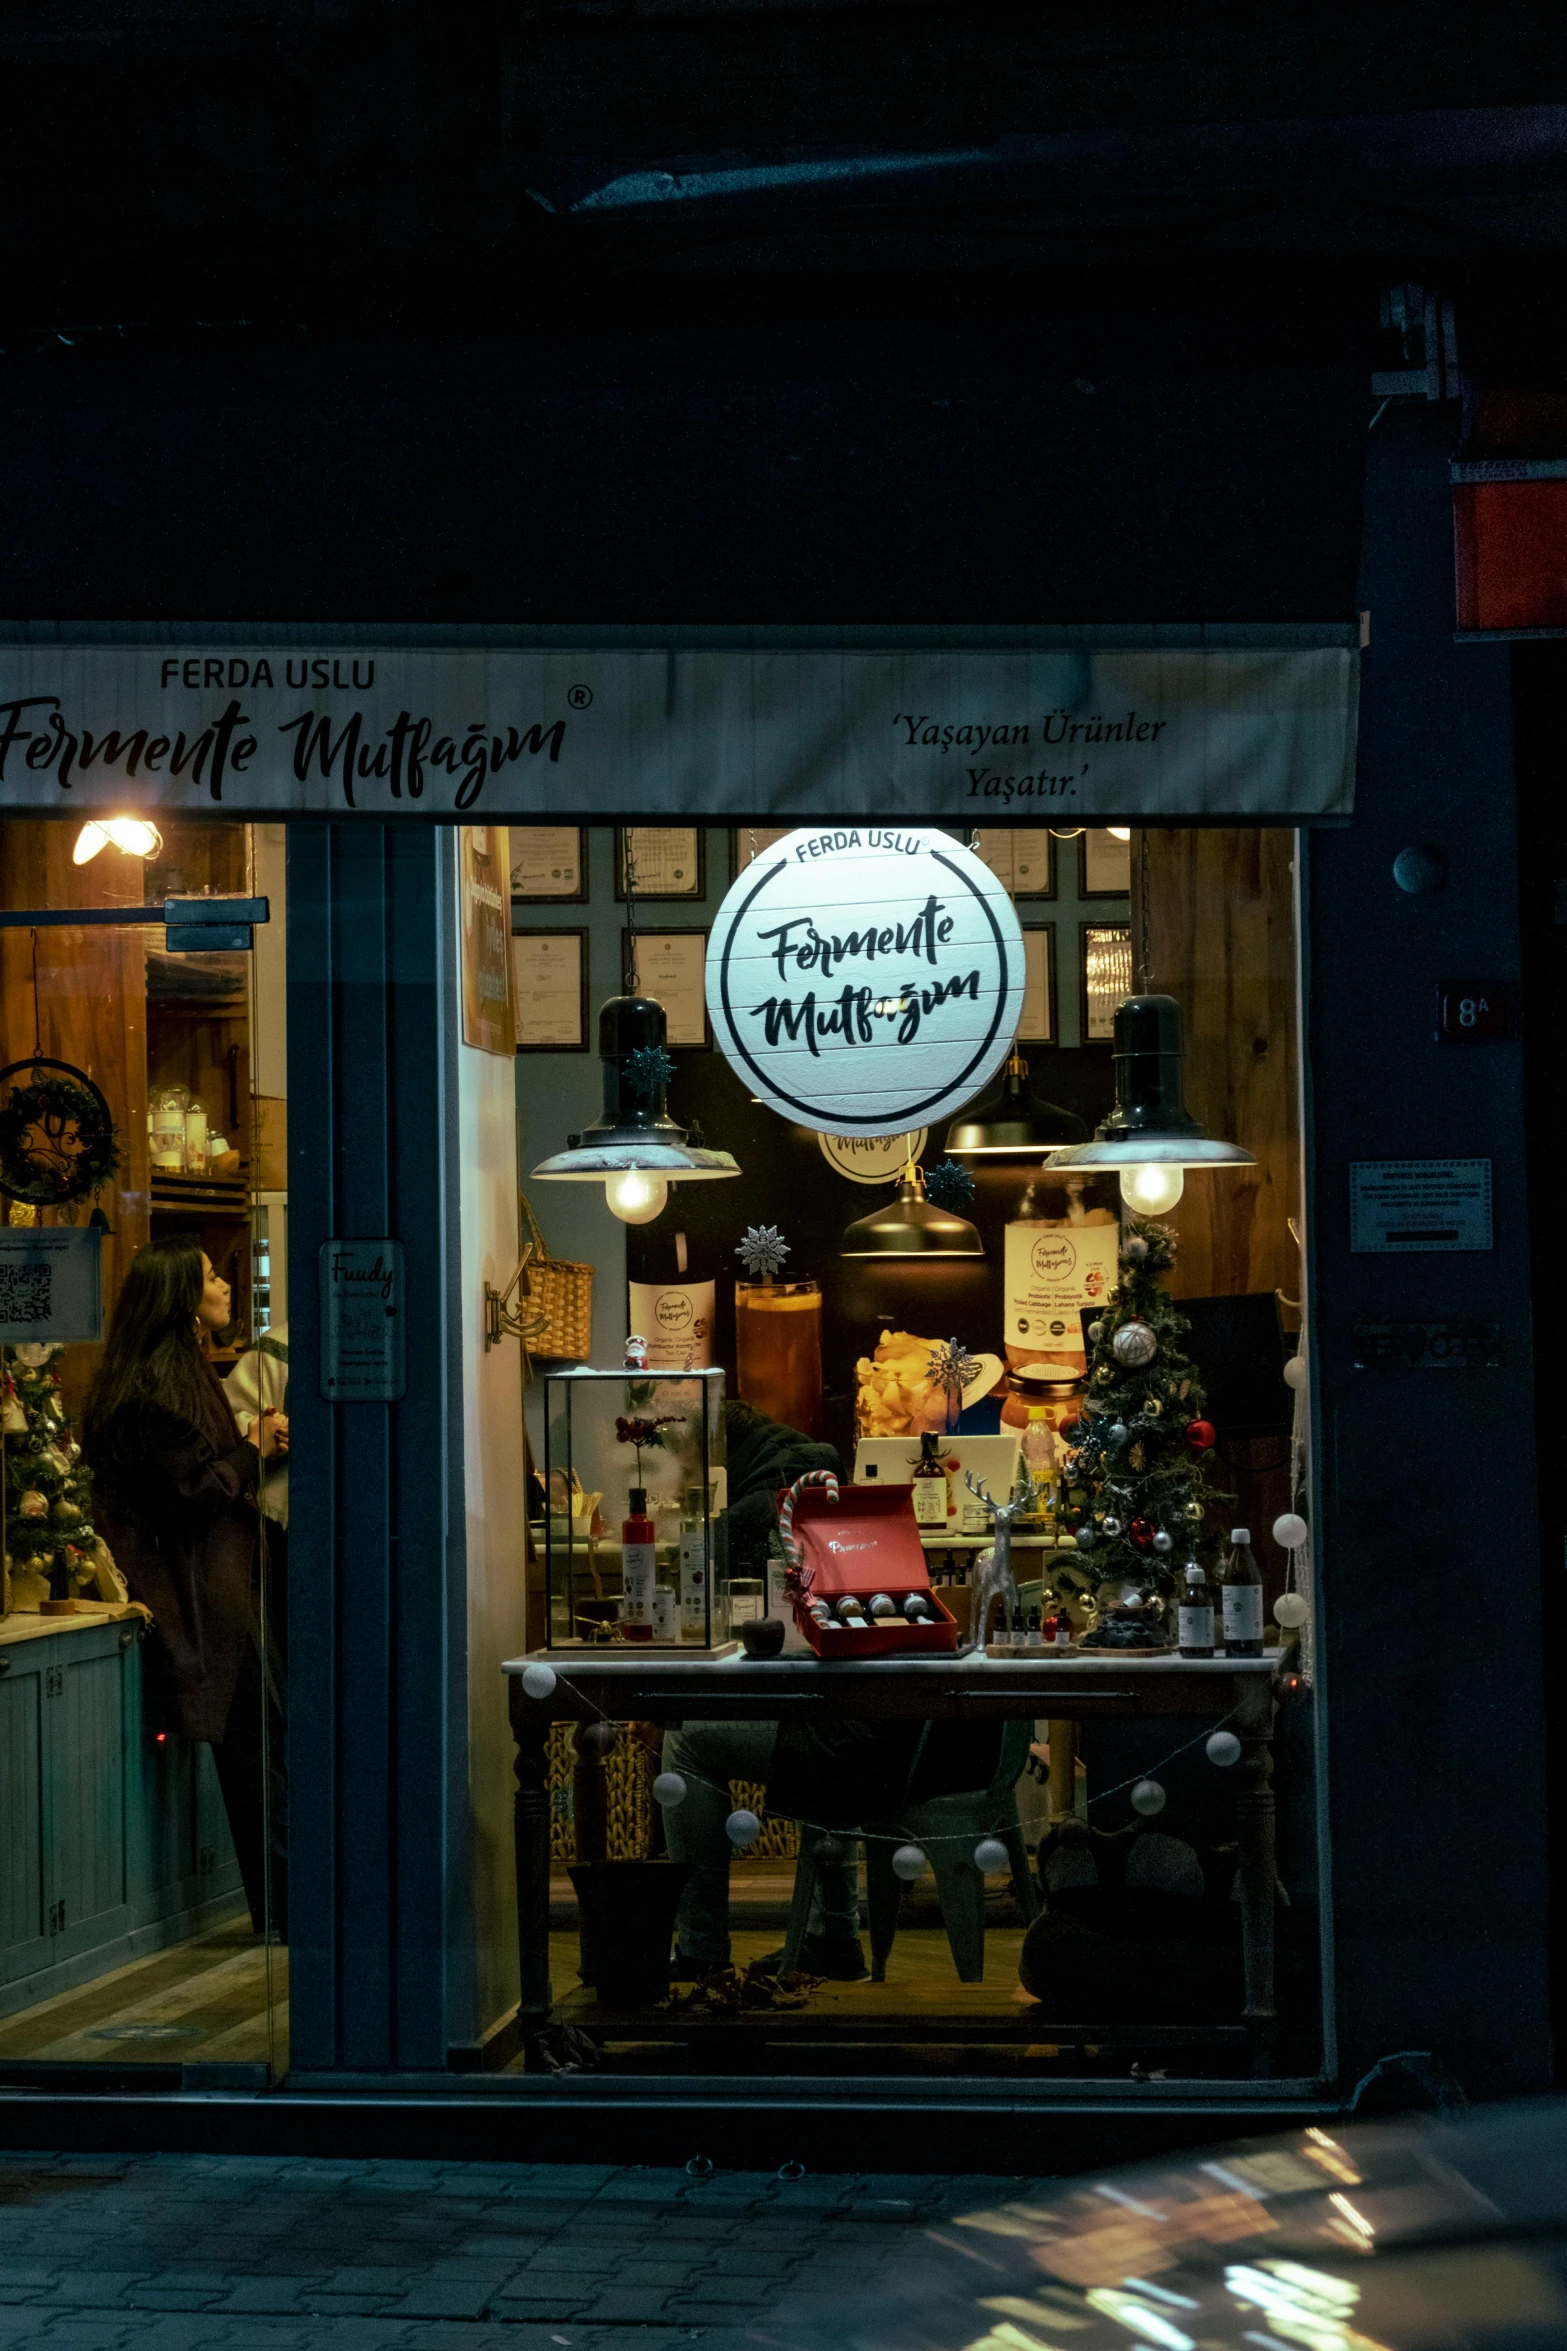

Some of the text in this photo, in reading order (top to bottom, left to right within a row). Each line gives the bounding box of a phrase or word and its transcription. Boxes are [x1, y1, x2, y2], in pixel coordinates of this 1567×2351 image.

[161, 658, 375, 690] FERDA USLU
[0, 696, 258, 801] Fermente
[278, 710, 567, 810] Mutfağım
[1042, 708, 1167, 745] Ürünler
[796, 829, 922, 863] FERDA USLU
[756, 894, 955, 983] Fermente
[749, 970, 981, 1058] Mutfağım
